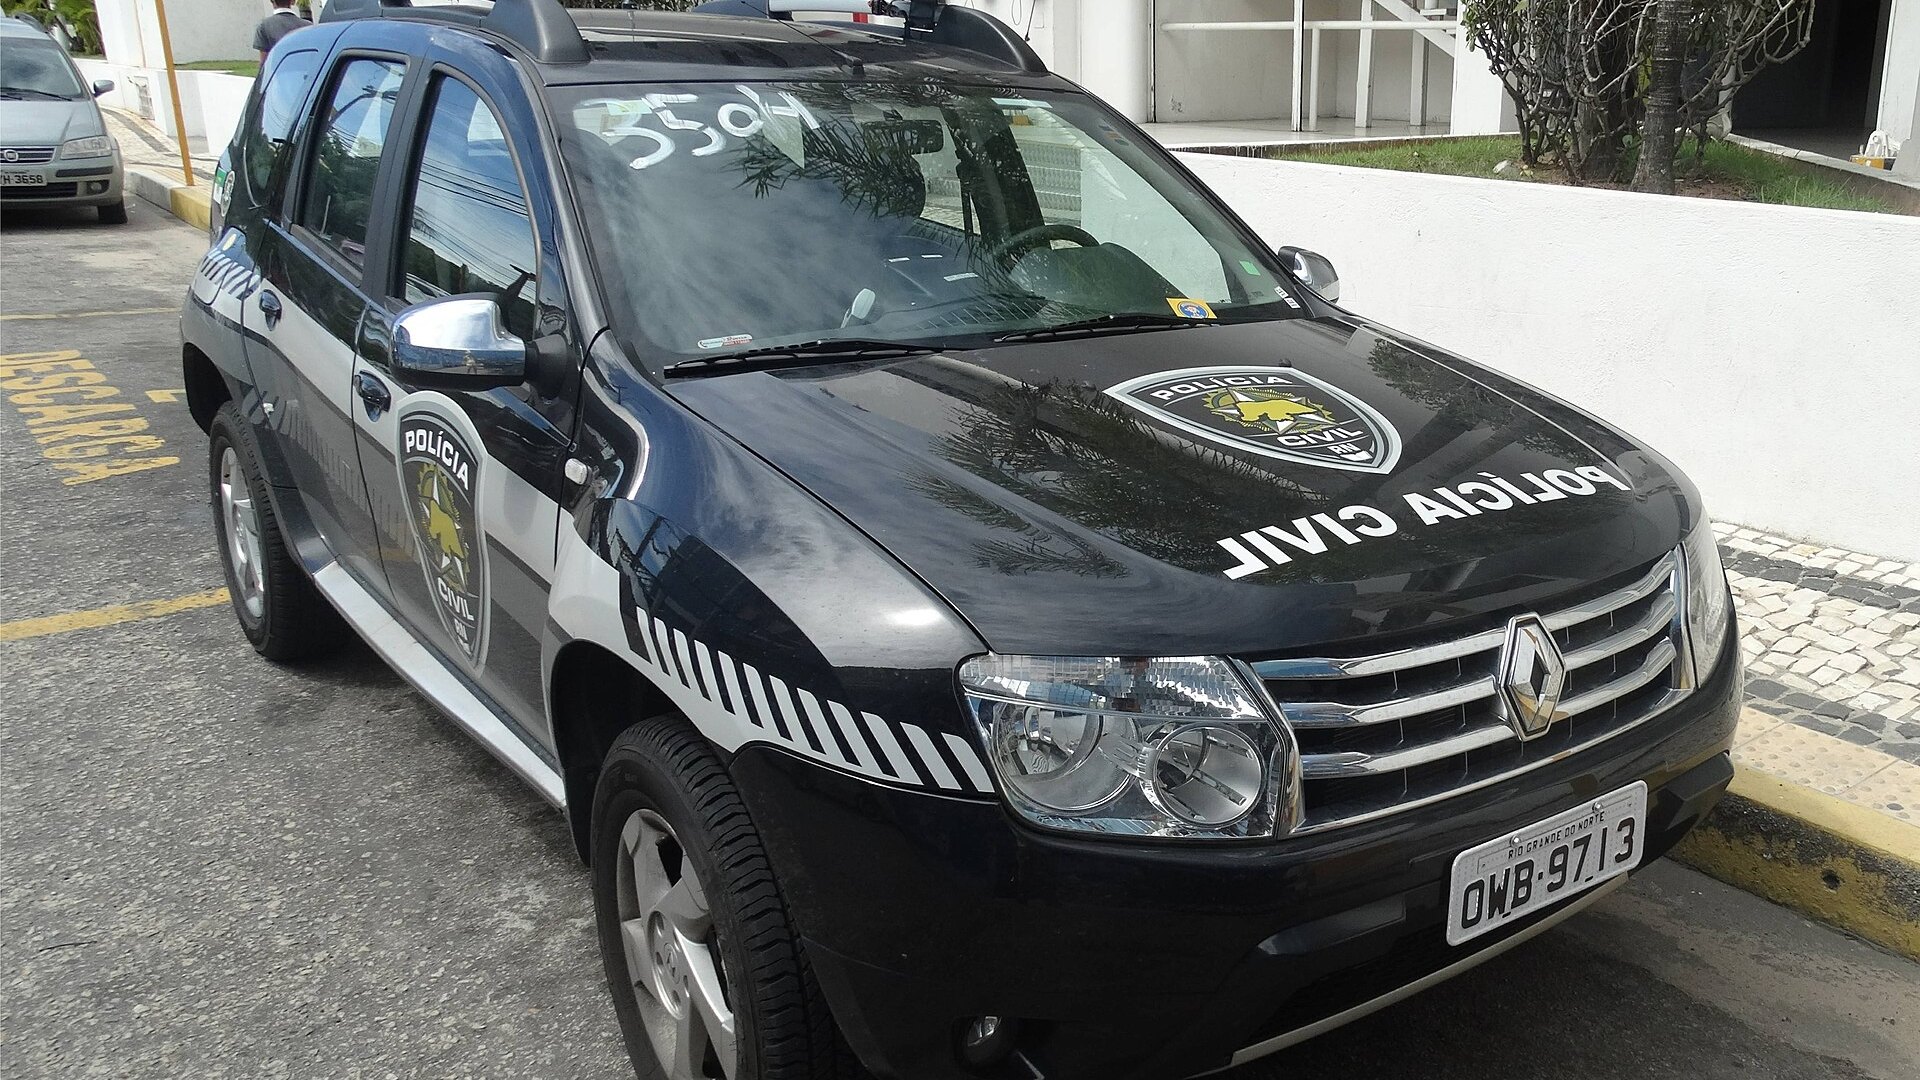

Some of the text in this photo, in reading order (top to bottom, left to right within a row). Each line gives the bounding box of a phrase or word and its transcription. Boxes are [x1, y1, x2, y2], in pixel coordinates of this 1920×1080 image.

[1150, 375, 1293, 401] POLÍCIA
[0, 349, 181, 486] DESCARGA
[1277, 425, 1364, 448] CIVIL
[405, 429, 469, 491] POLÍCIA
[1327, 442, 1362, 455] RN
[437, 577, 475, 622] CIVIL
[1508, 811, 1605, 860] RIO GRANDE DO NORTE
